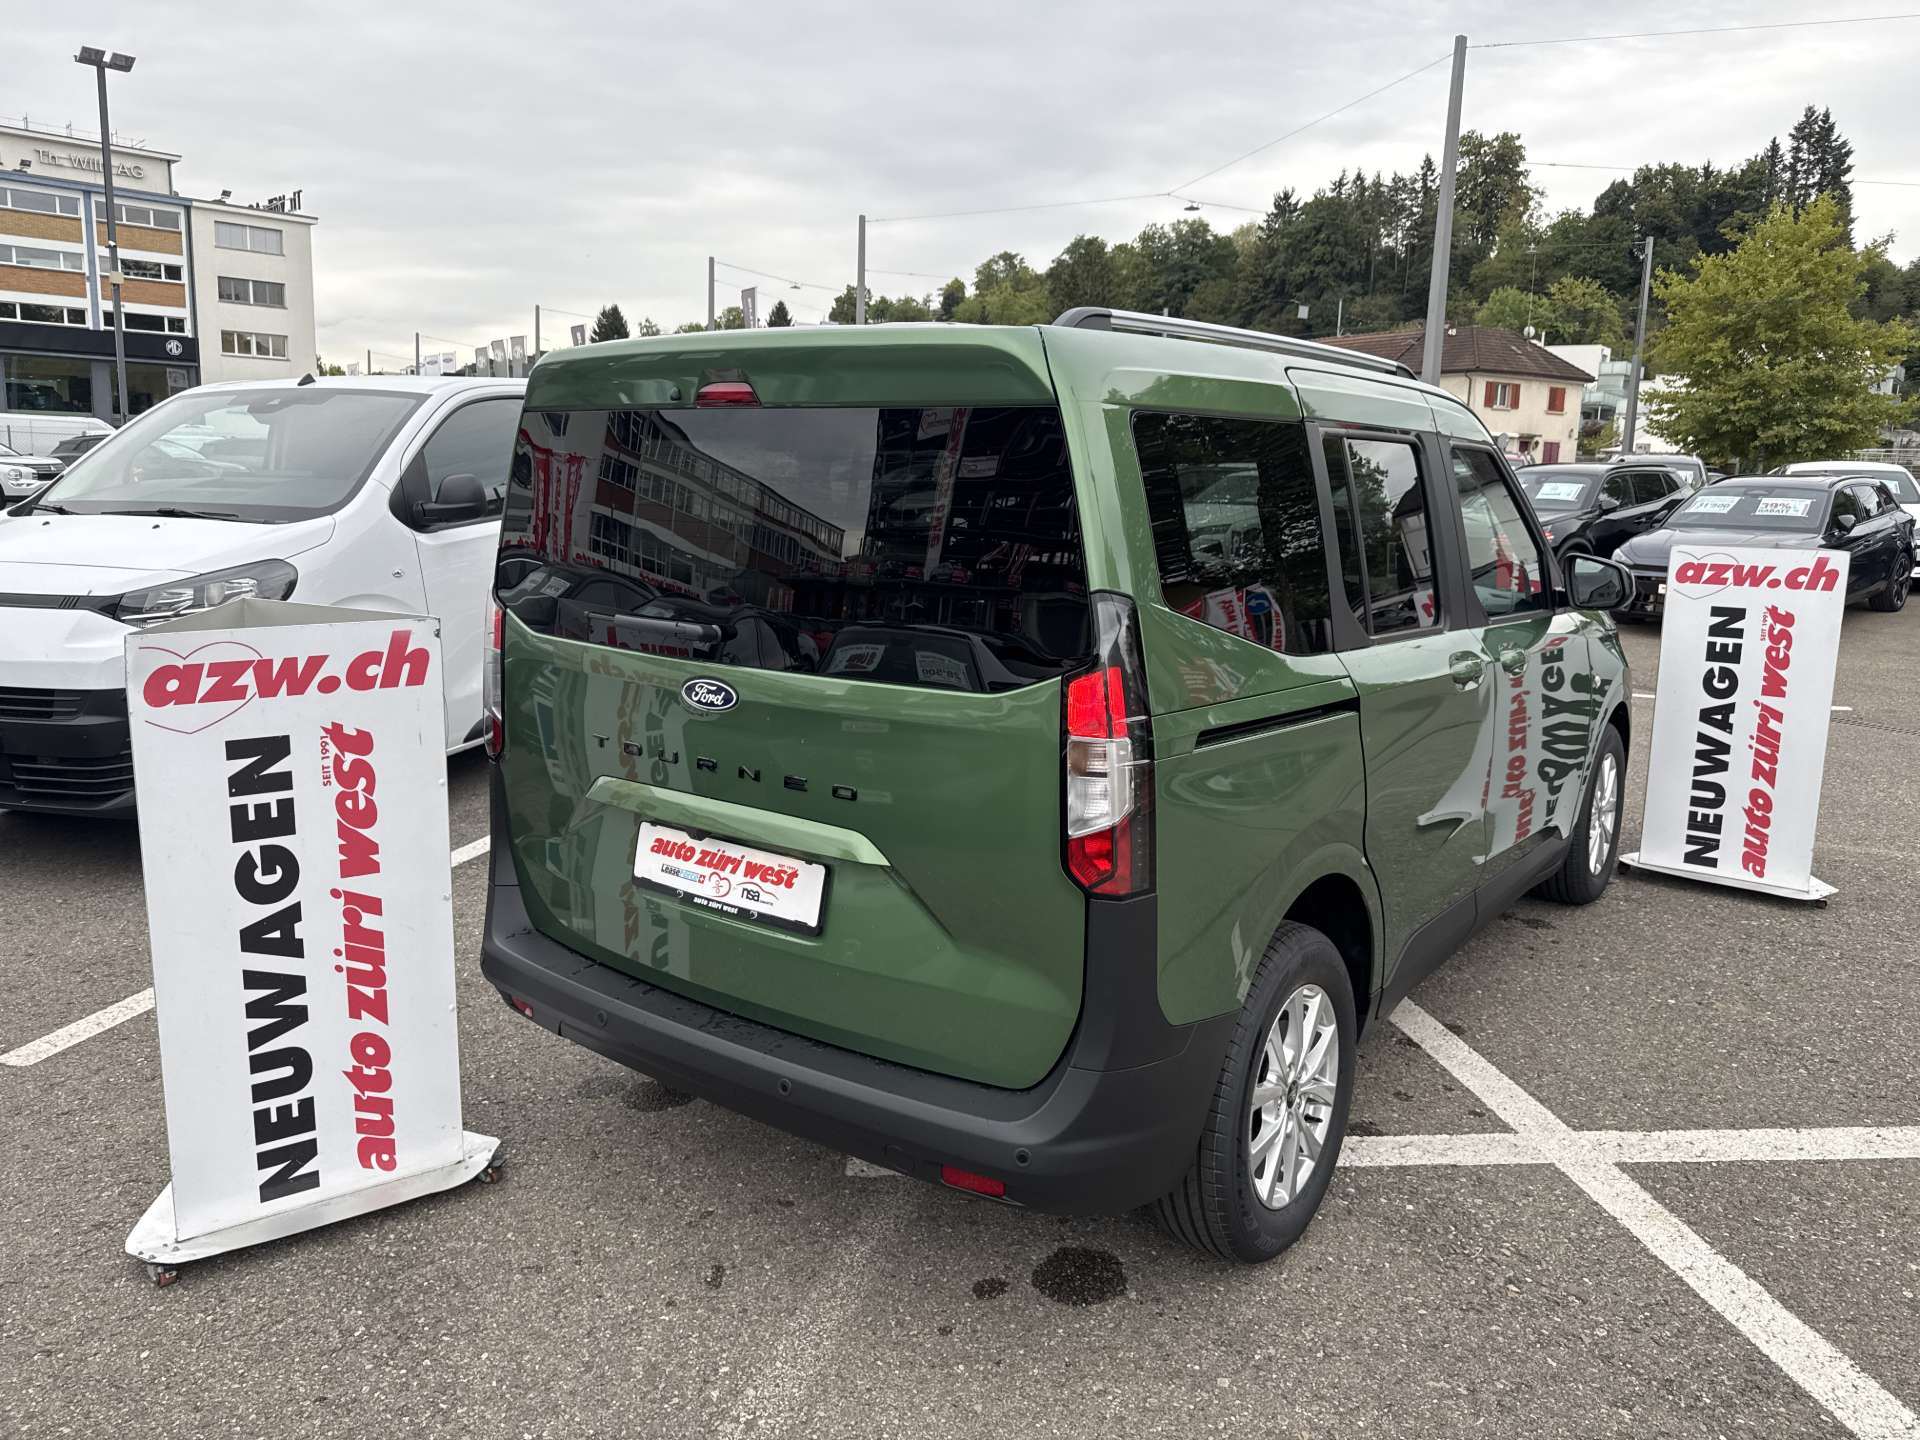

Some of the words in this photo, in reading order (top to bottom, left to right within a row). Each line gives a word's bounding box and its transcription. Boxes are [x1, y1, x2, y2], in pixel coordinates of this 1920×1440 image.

[117, 161, 144, 178] AG
[166, 340, 182, 355] MG
[1675, 557, 1840, 592] azw.ch
[143, 629, 431, 708] azw.ch
[1761, 604, 1796, 699] west
[691, 683, 724, 705] Ford
[320, 735, 330, 760] 1991
[593, 733, 858, 801] TOURNEO
[1683, 605, 1747, 868] NEUWAGEN
[1748, 699, 1784, 790] züri
[320, 721, 381, 880] west
[321, 764, 332, 787] SEIT
[650, 836, 696, 862] auto
[695, 848, 746, 875] züri
[744, 860, 799, 889] west
[1741, 788, 1773, 879] auto
[693, 896, 708, 906] auto
[723, 905, 739, 914] west
[741, 887, 760, 902] nsa
[224, 734, 320, 1203] NEUWAGEN
[329, 888, 389, 1026] züri
[342, 1031, 397, 1172] auto
